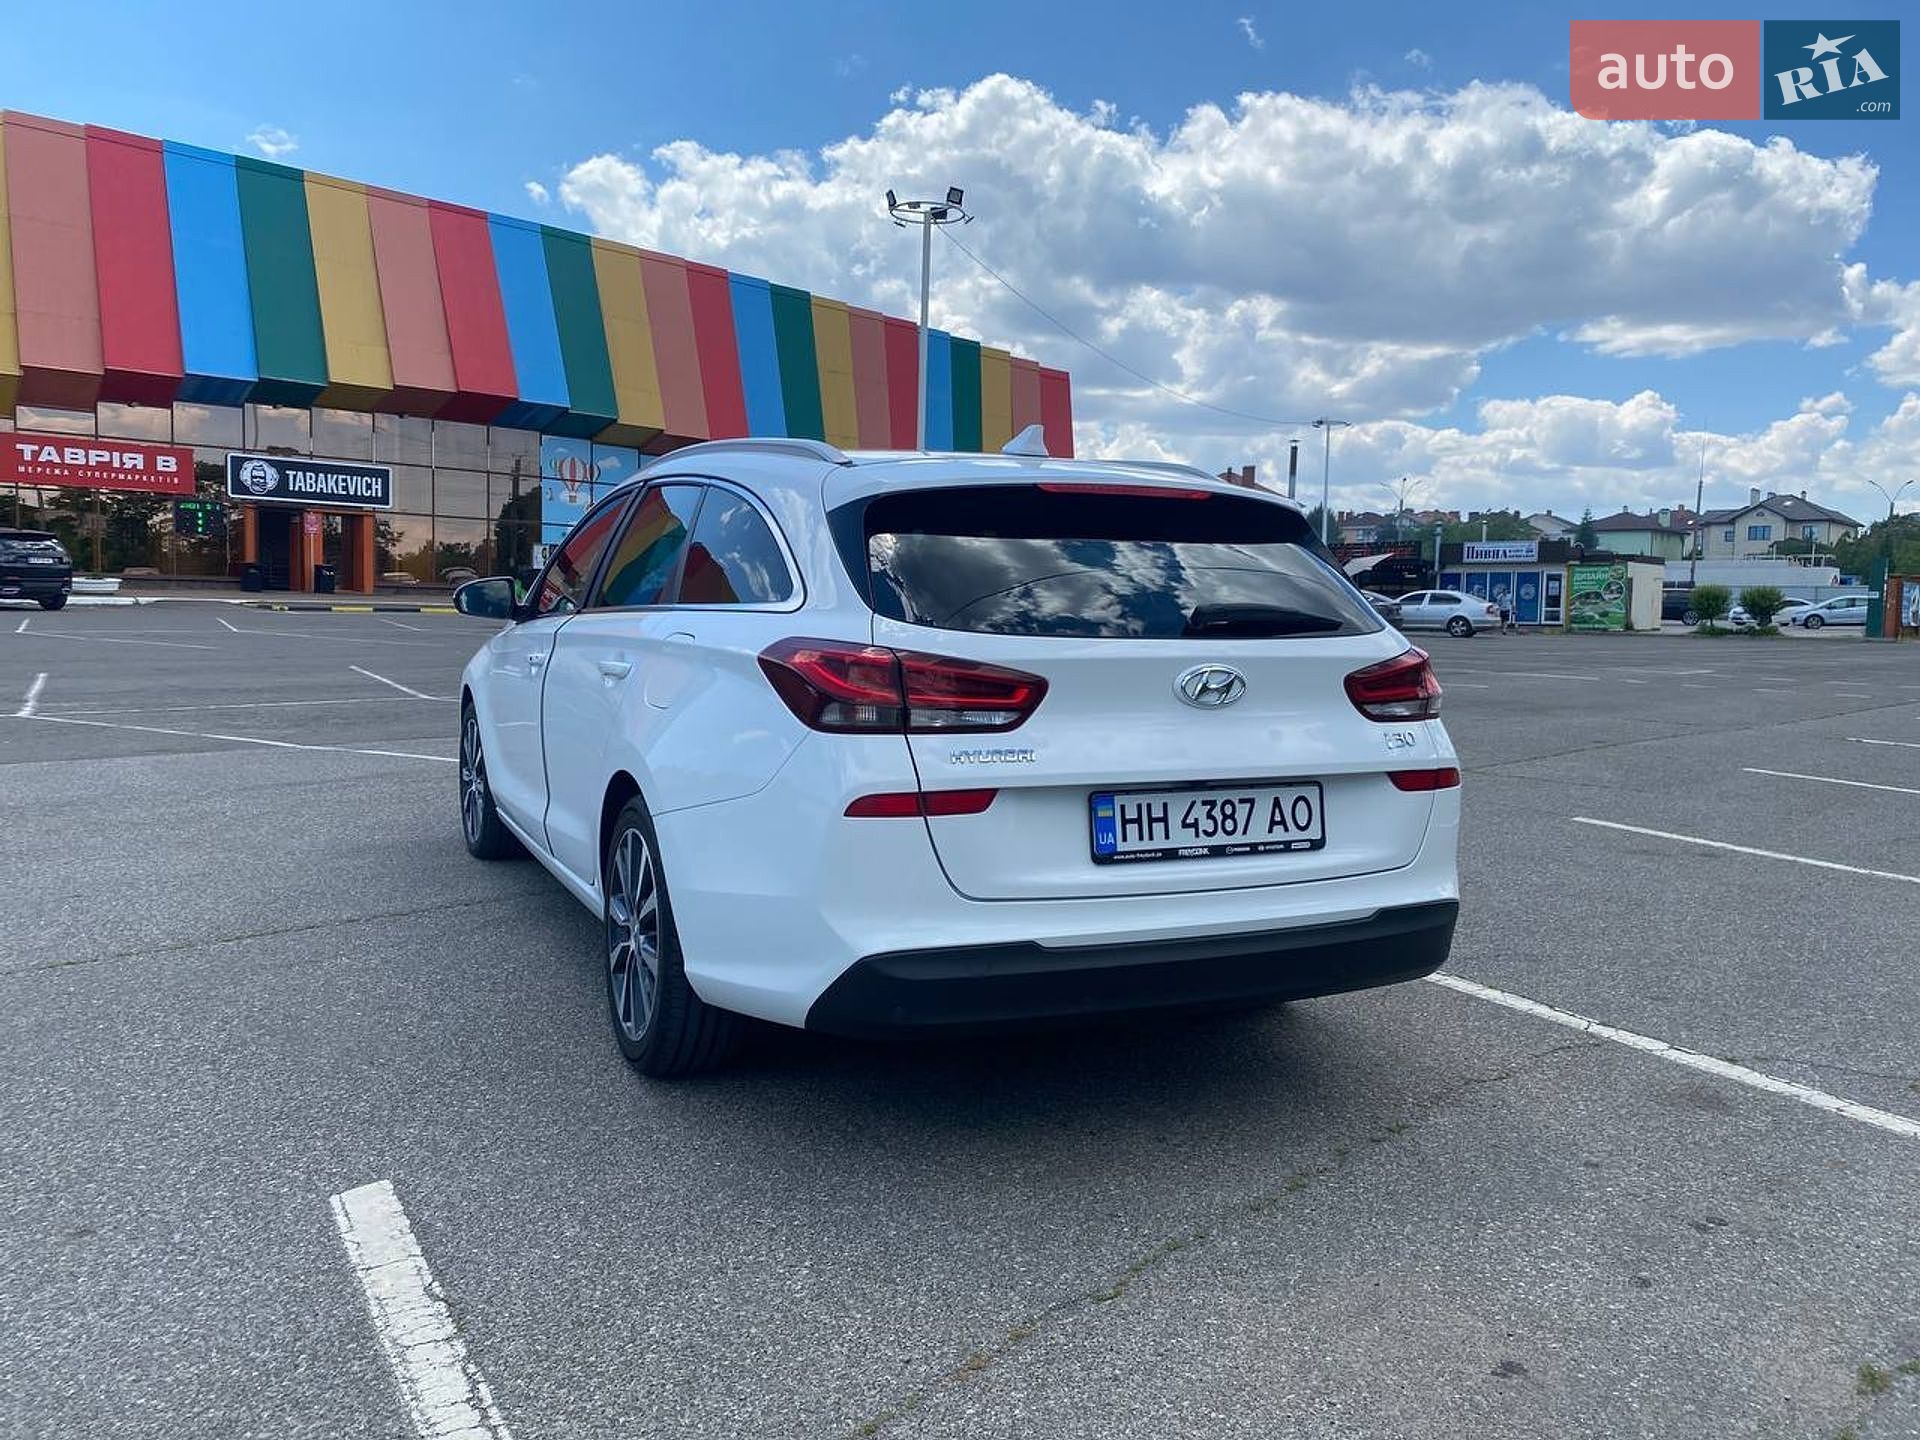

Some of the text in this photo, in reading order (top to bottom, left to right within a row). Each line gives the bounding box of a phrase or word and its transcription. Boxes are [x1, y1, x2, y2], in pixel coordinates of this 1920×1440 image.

[15, 443, 178, 473] ТАВРІЯ В
[17, 465, 70, 477] МЕРЕЖА
[285, 470, 383, 498] TABAKEVICH
[950, 749, 1036, 764] HYUNDAI
[1119, 794, 1313, 843] HH 4387 AO
[1099, 832, 1115, 845] UA
